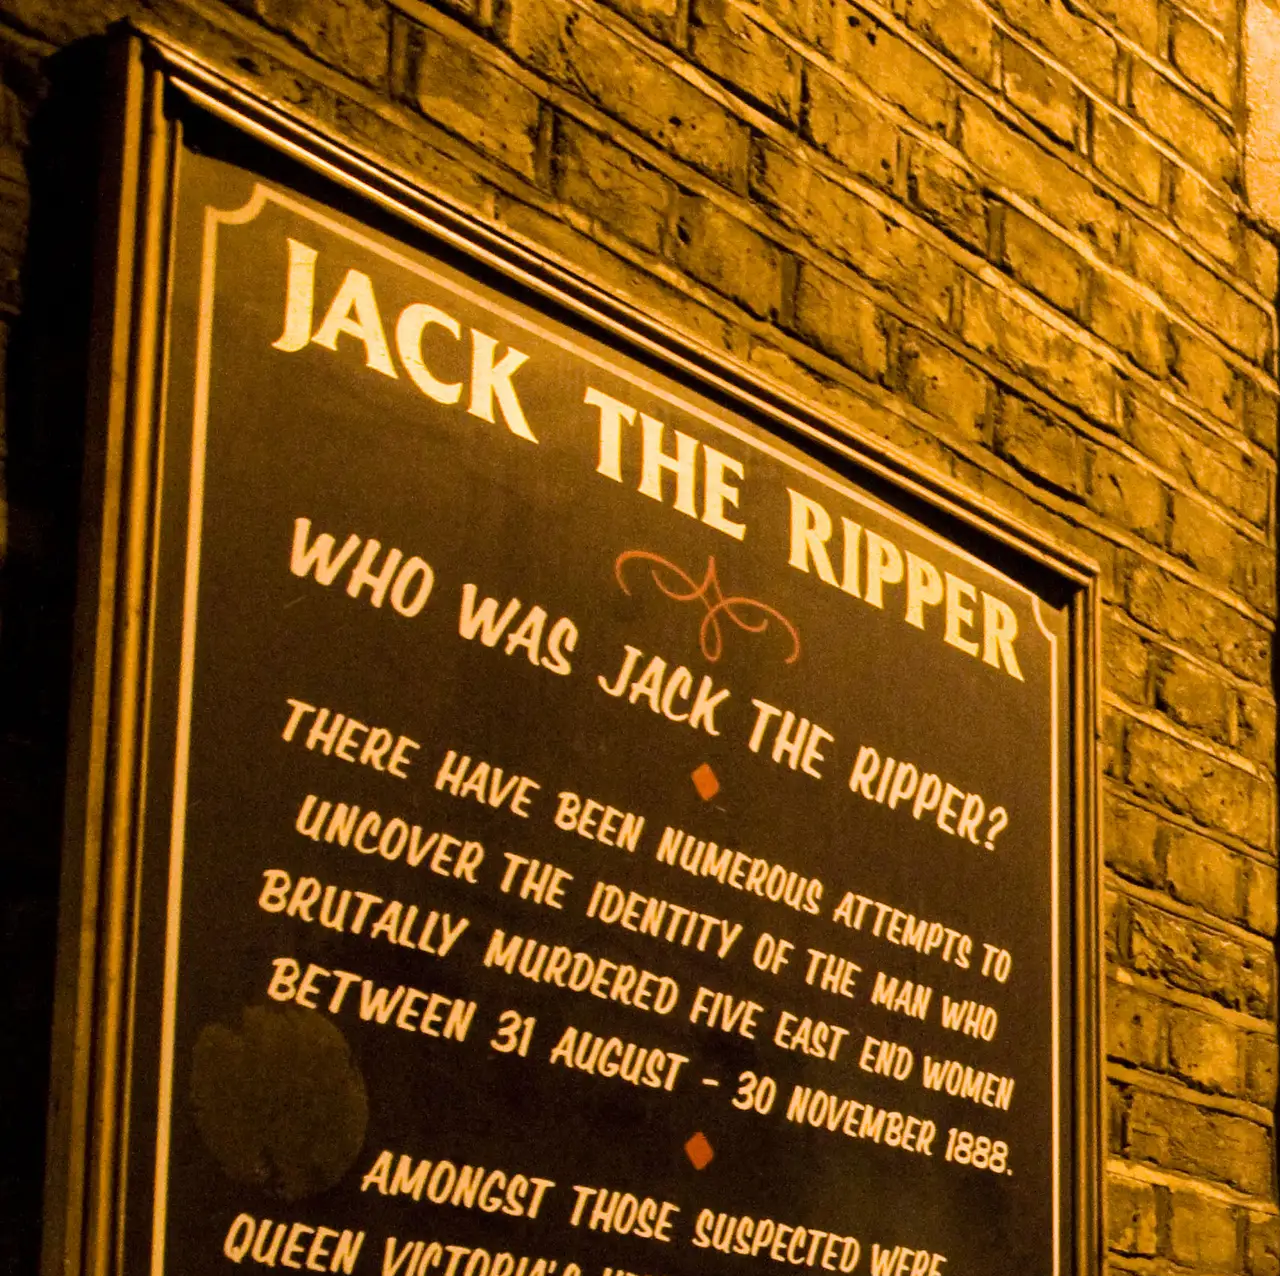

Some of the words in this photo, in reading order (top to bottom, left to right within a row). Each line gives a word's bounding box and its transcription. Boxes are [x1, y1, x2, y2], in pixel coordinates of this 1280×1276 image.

[272, 238, 539, 444] JACK
[584, 387, 746, 540] THE
[785, 488, 1024, 681] RIPPER
[290, 518, 434, 617] WHO
[459, 583, 578, 675] WAS
[598, 645, 730, 736] JACK
[749, 699, 834, 779] THE
[849, 746, 1008, 851] RIPPER?
[282, 699, 420, 779] THERE
[435, 750, 541, 818] HAVE
[554, 791, 645, 852] BEEN
[656, 826, 824, 915] NUMEROUS
[833, 892, 973, 969] ATTEMPTS
[981, 943, 1012, 983] TO
[296, 794, 484, 884] UNCOVER
[500, 852, 574, 909] THE
[586, 881, 743, 959] IDENTITY
[753, 933, 795, 974] OF
[806, 949, 862, 998] THE
[871, 972, 932, 1020] MAN
[942, 996, 998, 1041] WHO
[259, 869, 470, 957] BRUTALLY
[483, 929, 679, 1015] MURDERED
[689, 987, 764, 1039] FIVE
[774, 1011, 850, 1061] EAST
[859, 1036, 913, 1081] END
[923, 1056, 1015, 1111] WOMEN
[267, 957, 477, 1042] BETWEEN
[490, 1010, 536, 1057] 31
[549, 1026, 690, 1091] AUGUST
[732, 1071, 777, 1115] 30
[786, 1085, 936, 1156] NOVEMBER
[945, 1128, 1013, 1176] 1888.
[223, 1213, 365, 1275] QUEEN
[361, 1150, 556, 1219] AMONGST
[570, 1185, 680, 1242] THOSE
[692, 1208, 861, 1273] SUSPECTED
